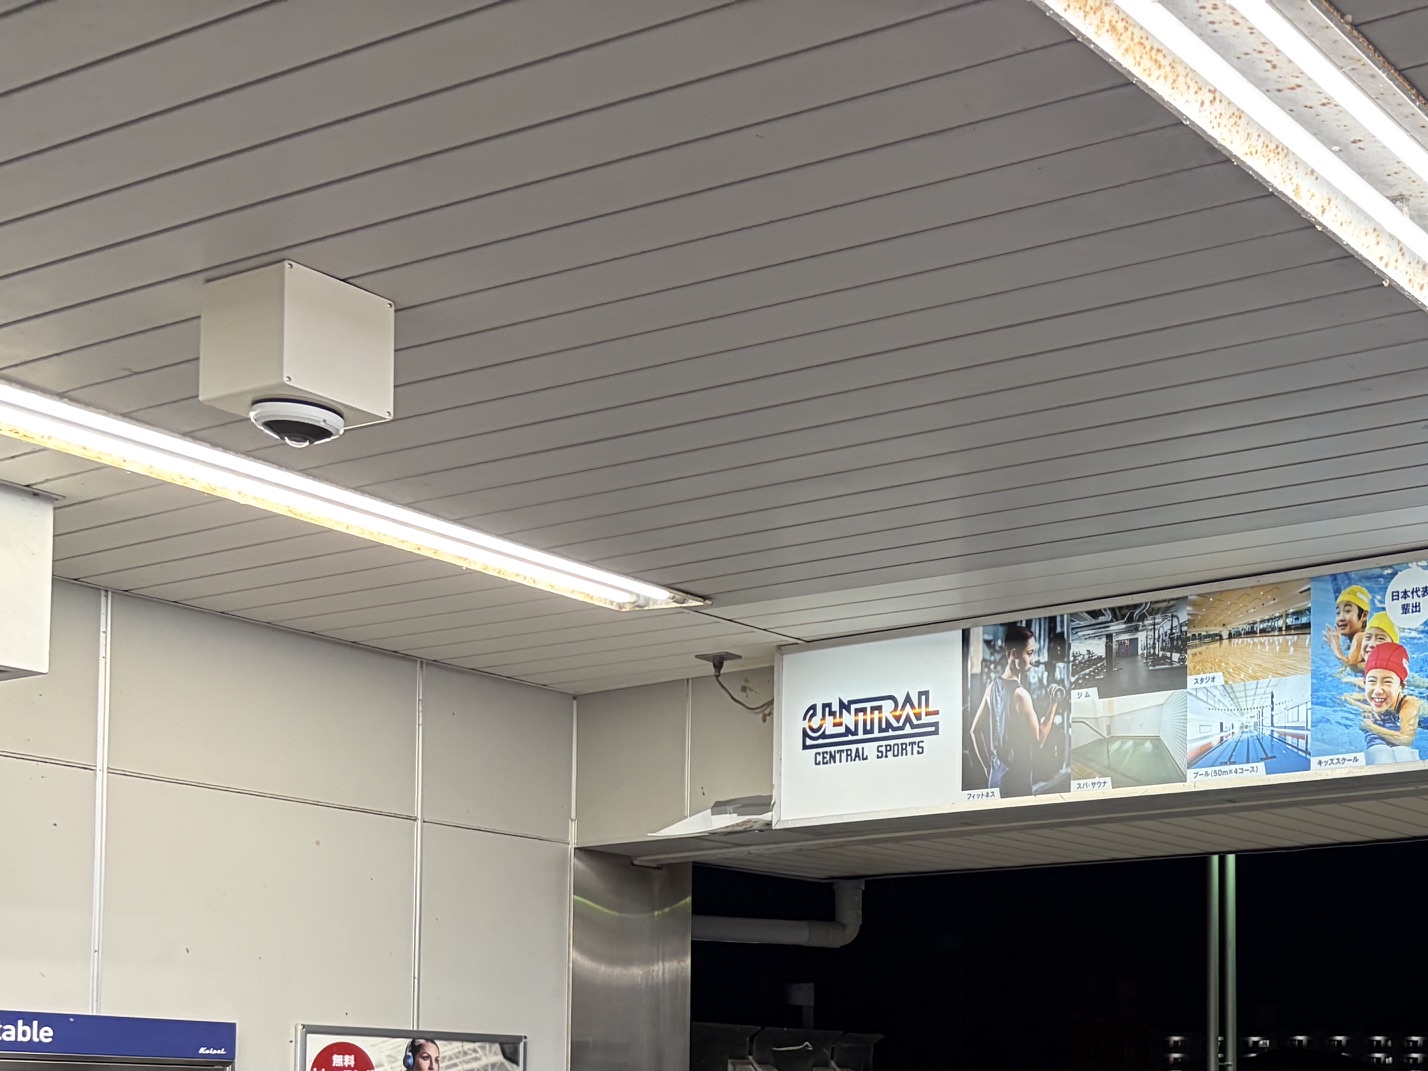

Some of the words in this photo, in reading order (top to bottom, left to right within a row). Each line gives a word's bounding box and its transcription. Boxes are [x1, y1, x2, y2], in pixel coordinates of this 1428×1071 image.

[1400, 601, 1421, 615] 輩出
[1193, 675, 1217, 685] スタジオ
[1076, 690, 1091, 699] ジム
[802, 690, 940, 751] CENTRAL
[814, 746, 868, 766] CENTRAL
[876, 740, 925, 759] SPORTS
[1316, 756, 1360, 767] キッズスクール
[966, 790, 996, 800] フィットネス
[0, 1019, 54, 1043] able
[332, 1053, 355, 1068] 無料
